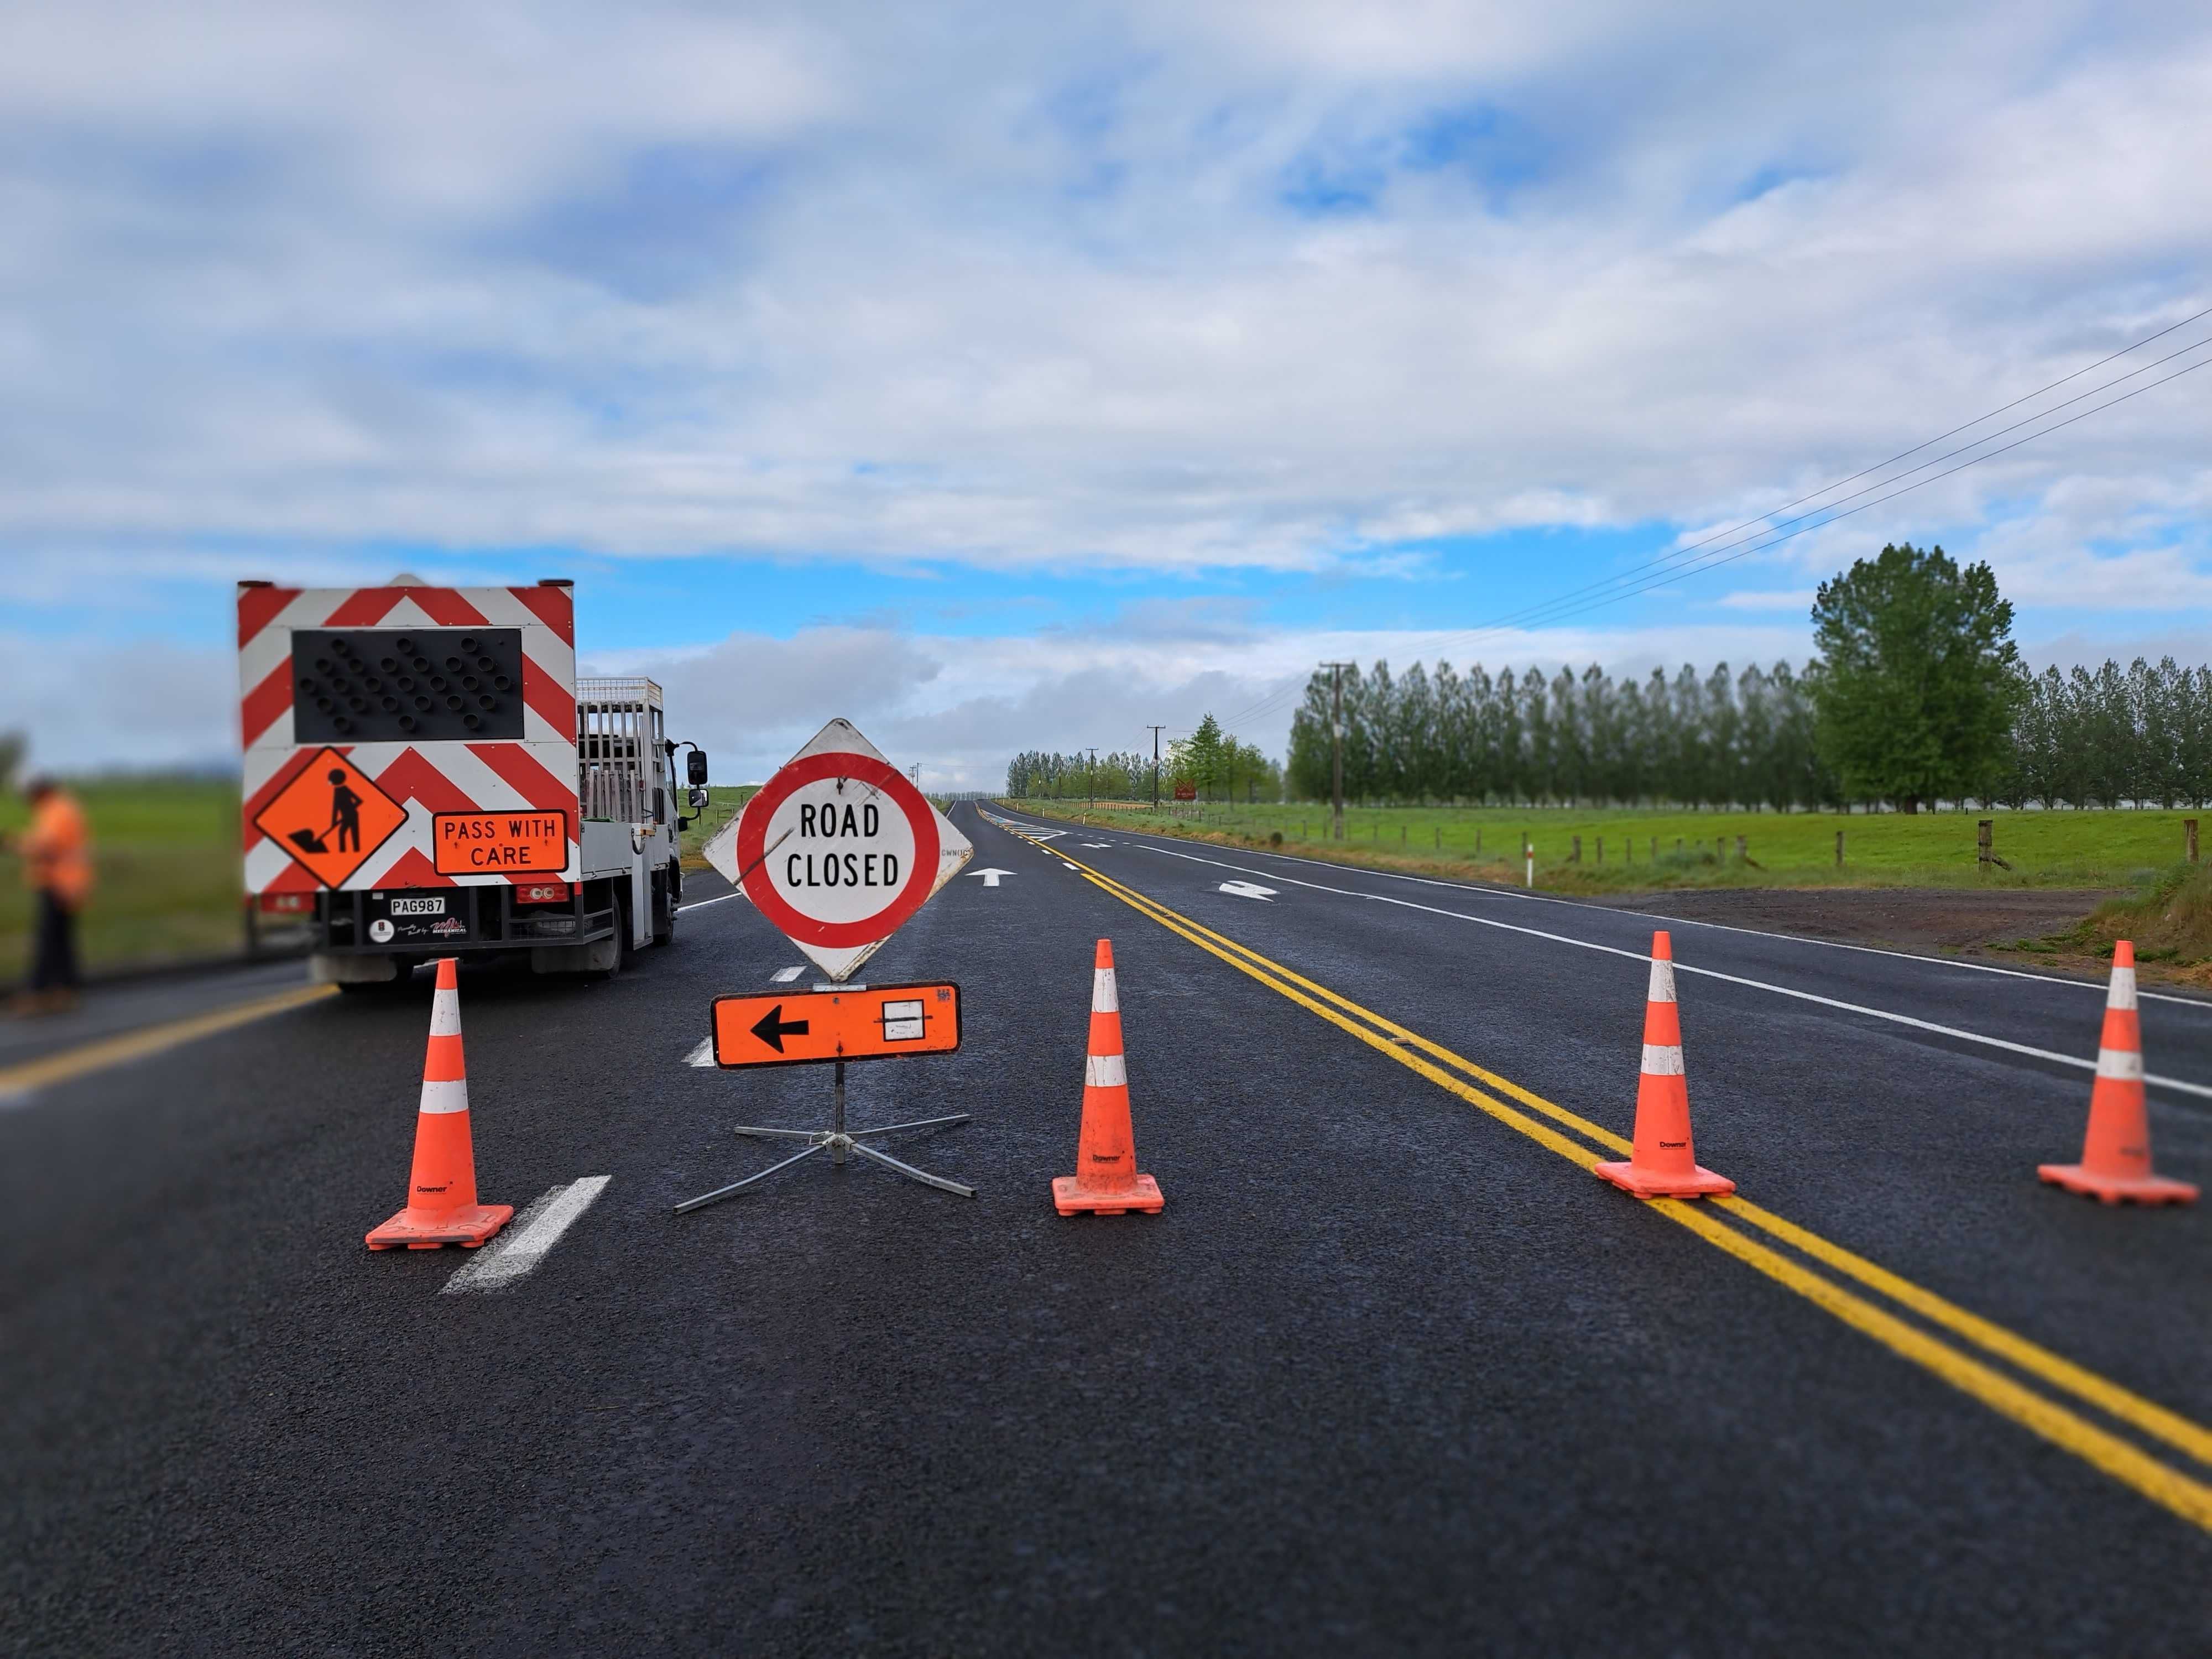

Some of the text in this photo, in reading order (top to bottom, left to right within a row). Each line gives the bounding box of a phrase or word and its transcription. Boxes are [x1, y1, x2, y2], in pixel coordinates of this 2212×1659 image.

[445, 820, 555, 840] PASS WITH
[801, 803, 879, 837] ROAD
[471, 846, 531, 866] CARE
[787, 853, 898, 887] CLOSED
[393, 900, 442, 913] PAG987
